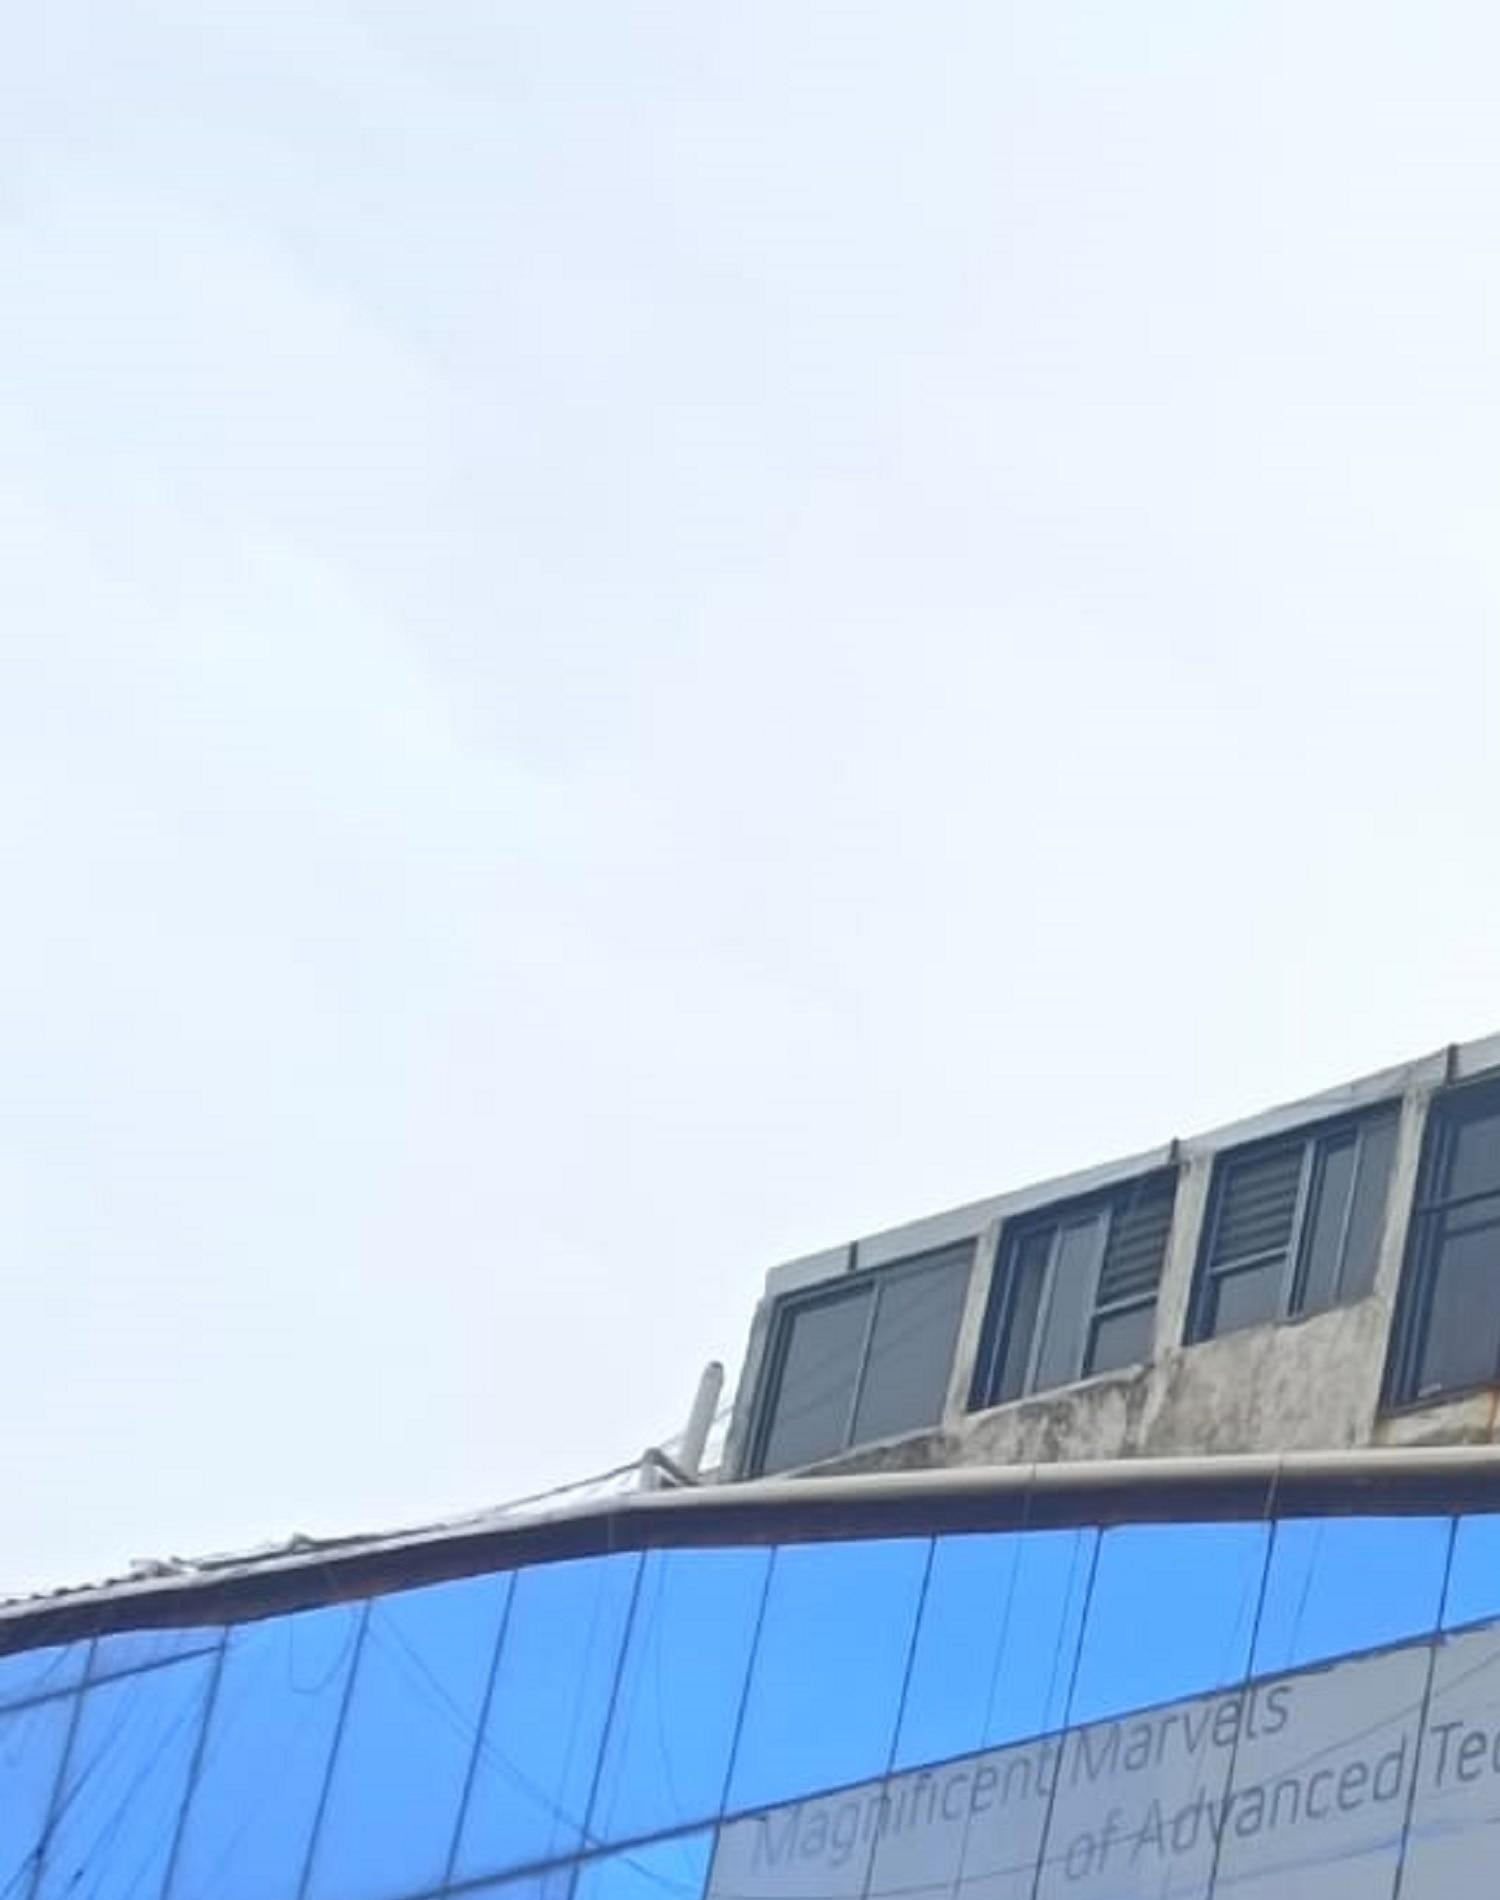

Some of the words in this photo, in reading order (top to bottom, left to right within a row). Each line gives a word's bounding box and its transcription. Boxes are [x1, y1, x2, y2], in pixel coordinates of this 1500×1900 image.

[748, 1742, 1057, 1873] Magnificent
[1070, 1678, 1291, 1783] Marvels
[1063, 1815, 1117, 1882] of
[1130, 1737, 1406, 1862] Advanced
